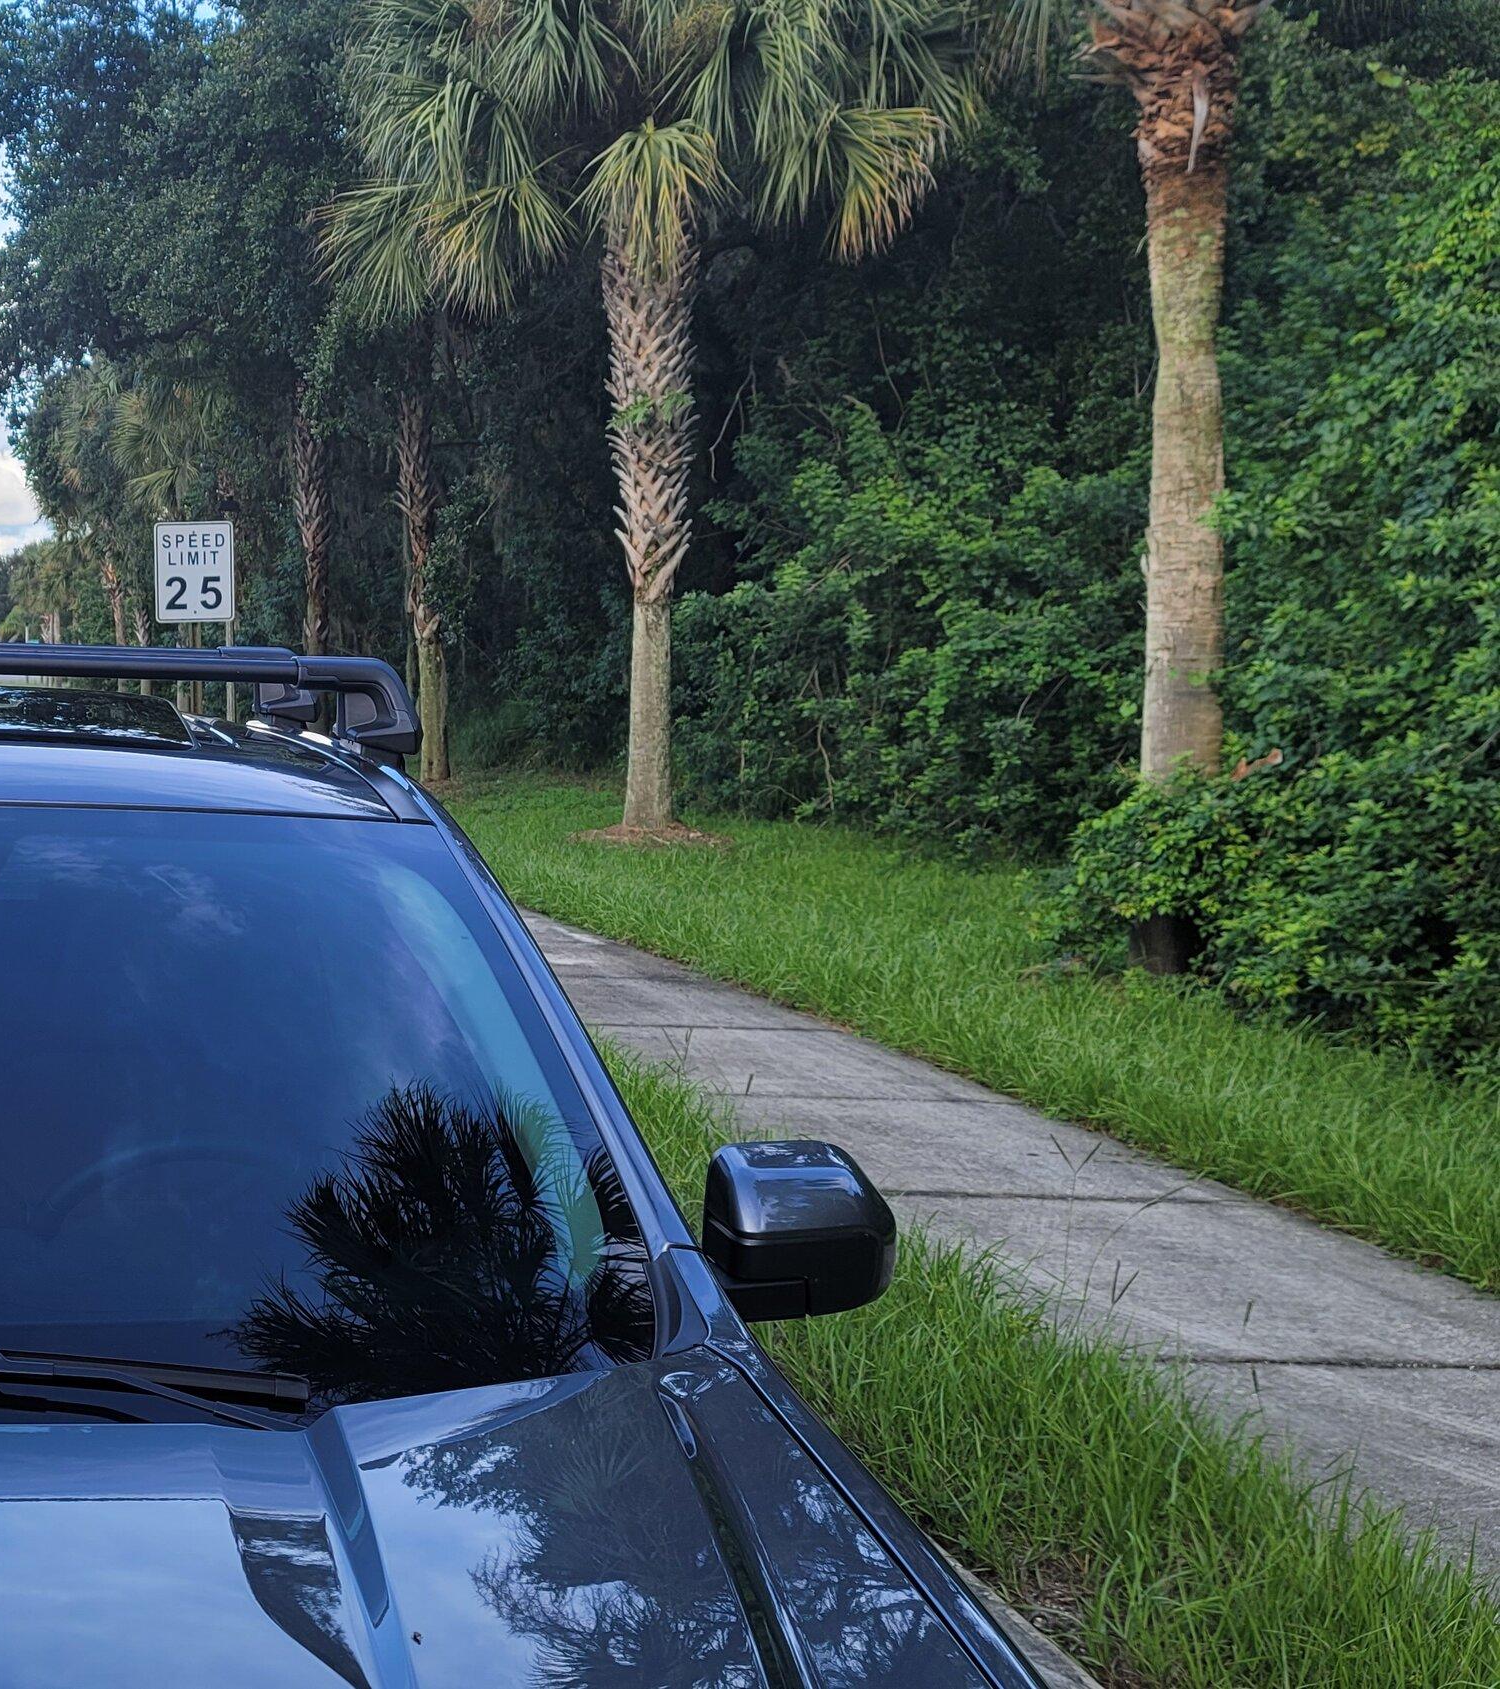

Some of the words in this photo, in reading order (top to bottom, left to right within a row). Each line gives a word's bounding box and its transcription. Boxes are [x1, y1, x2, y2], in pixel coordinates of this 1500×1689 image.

[162, 533, 225, 549] SPEED
[168, 551, 219, 566] LIMIT
[165, 576, 223, 610] 25
